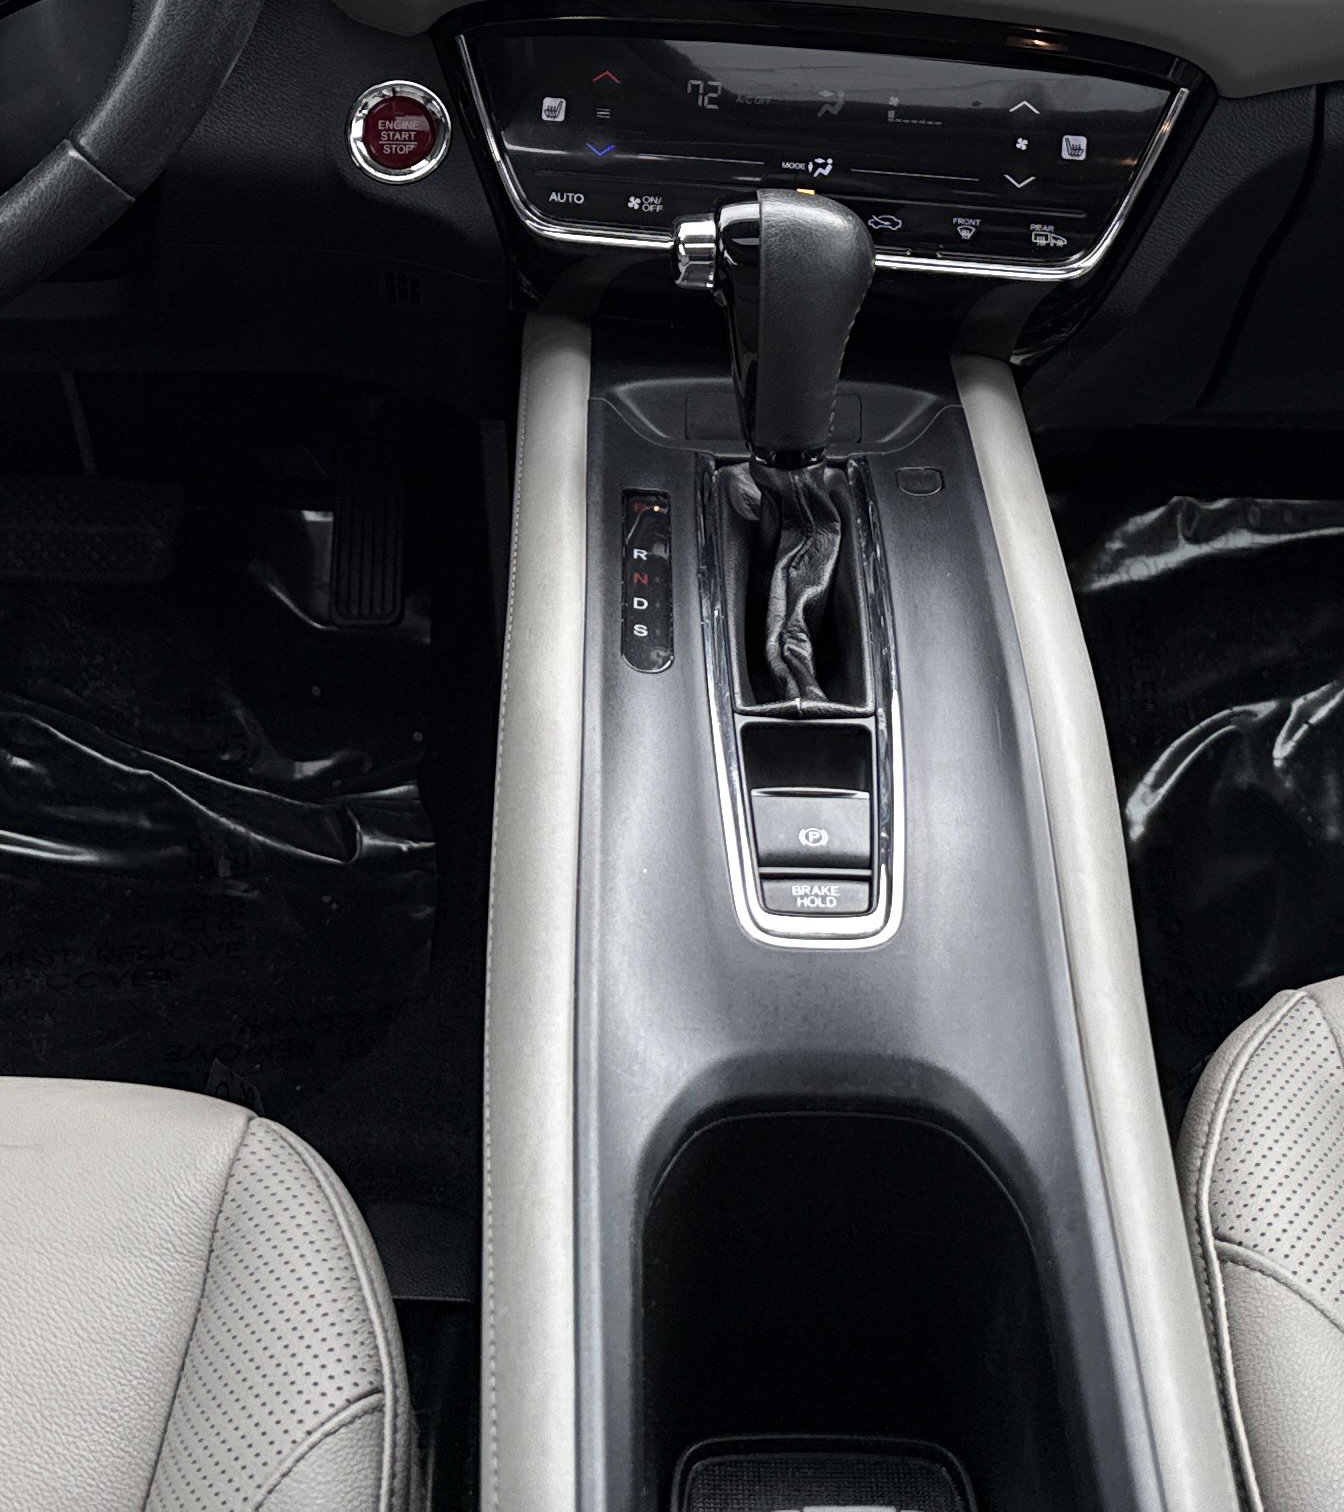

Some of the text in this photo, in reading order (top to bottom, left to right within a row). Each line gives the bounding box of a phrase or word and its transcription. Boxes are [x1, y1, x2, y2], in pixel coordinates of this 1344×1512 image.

[687, 79, 722, 110] 72
[378, 119, 419, 130] ENGINE
[381, 131, 416, 141] START
[383, 144, 415, 155] STOP
[782, 161, 806, 170] MODE
[549, 192, 584, 204] AUTO
[642, 204, 663, 213] OFF
[952, 217, 981, 226] FRONT
[1030, 223, 1055, 232] REAR
[633, 549, 648, 561] R
[633, 572, 649, 585] N
[633, 597, 649, 610] D
[633, 624, 649, 637] S
[791, 884, 840, 896] BRAKE
[797, 896, 836, 907] HOLD
